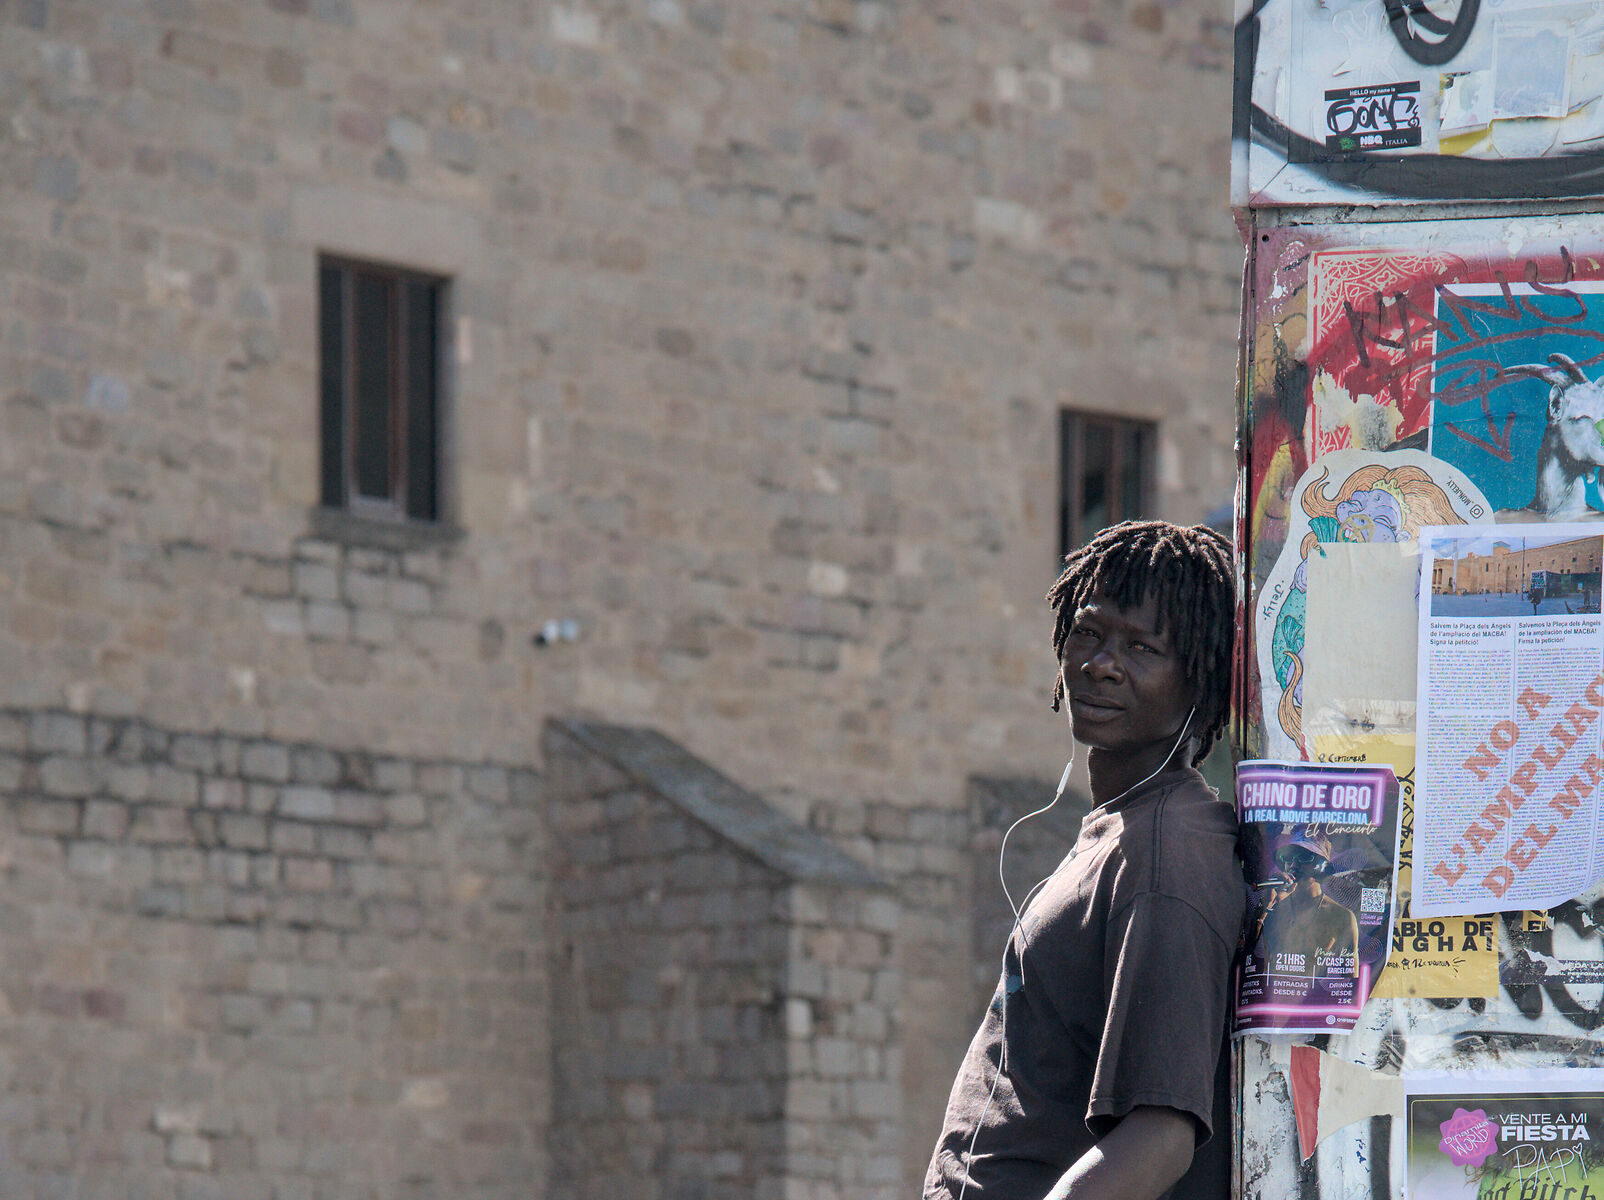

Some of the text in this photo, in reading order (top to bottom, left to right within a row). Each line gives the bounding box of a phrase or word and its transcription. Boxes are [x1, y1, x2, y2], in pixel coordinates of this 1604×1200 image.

[1349, 88, 1369, 96] HELLO
[1385, 138, 1408, 146] ITALIA
[1462, 720, 1521, 782] NO
[1517, 686, 1552, 721] A
[1243, 782, 1371, 810] CHINO DE ORO
[1244, 809, 1368, 825] LA REAL MOVIE BARCELONA
[1325, 820, 1377, 835] Concierto
[1480, 822, 1559, 899] DEL
[1276, 953, 1306, 966] 21HRS
[1345, 958, 1355, 967] 39
[1275, 964, 1306, 973] OPEN DOORS
[1273, 980, 1308, 988] ENTRADAS
[1499, 1112, 1588, 1125] VENTE A MI
[1444, 1120, 1489, 1145] Dinamita
[1501, 1125, 1591, 1142] FIESTA
